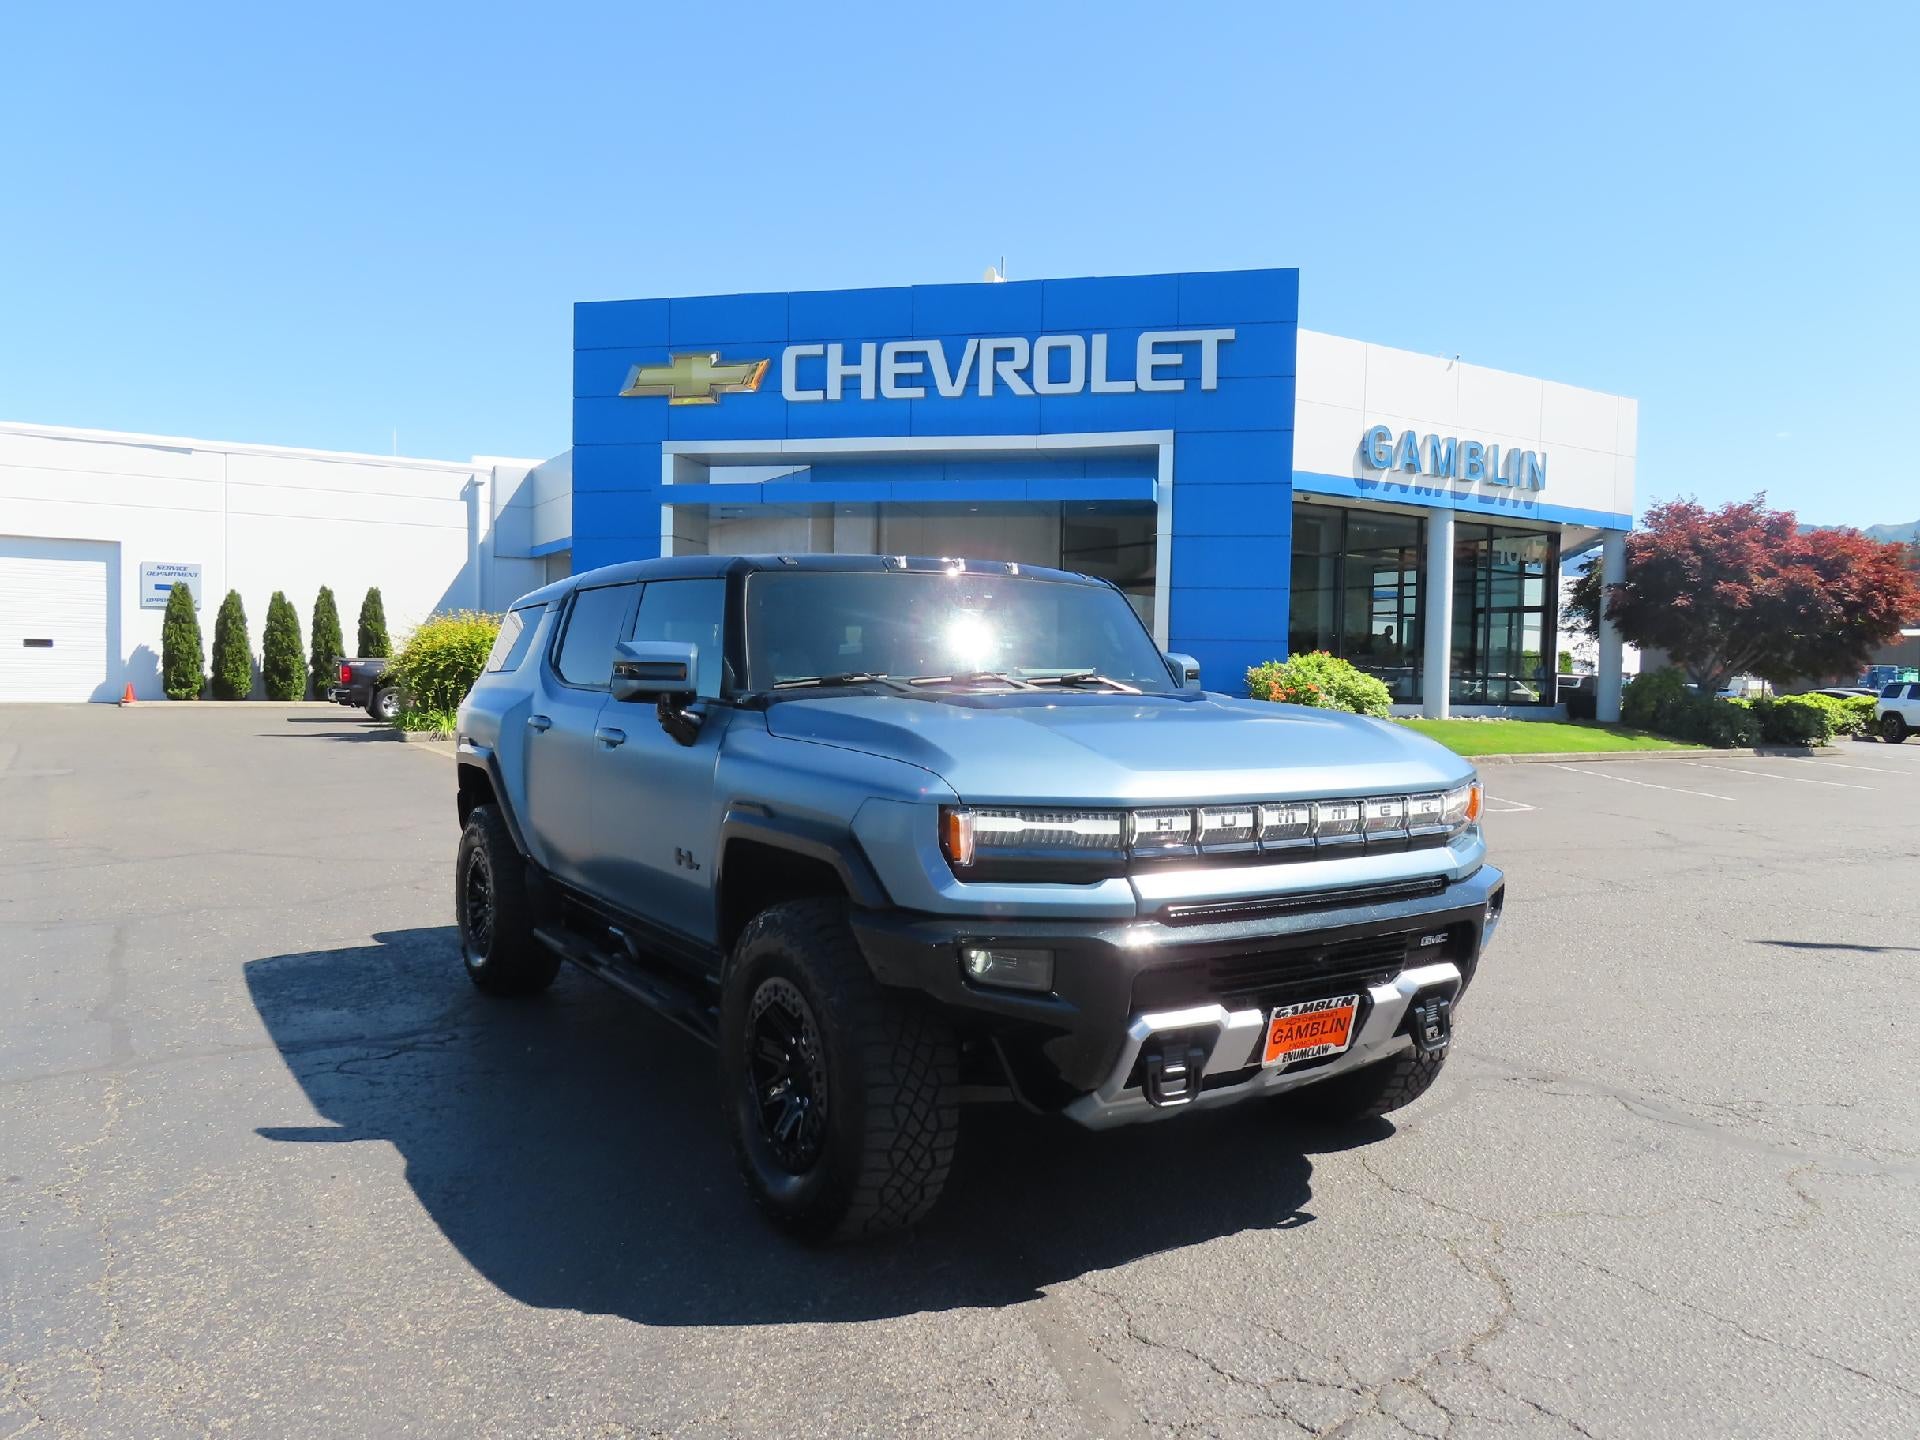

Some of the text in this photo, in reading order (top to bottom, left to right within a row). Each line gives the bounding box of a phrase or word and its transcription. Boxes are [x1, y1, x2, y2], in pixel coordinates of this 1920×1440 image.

[781, 328, 1236, 401] CHEVROLET
[1364, 424, 1547, 491] GAMBLIN
[1155, 801, 1433, 831] HUMMER
[1420, 932, 1449, 946] GMC
[1275, 995, 1356, 1019] GAMBLIN
[1272, 1017, 1347, 1045] GAMBLIN
[1282, 1045, 1330, 1063] ENUMCLAW
